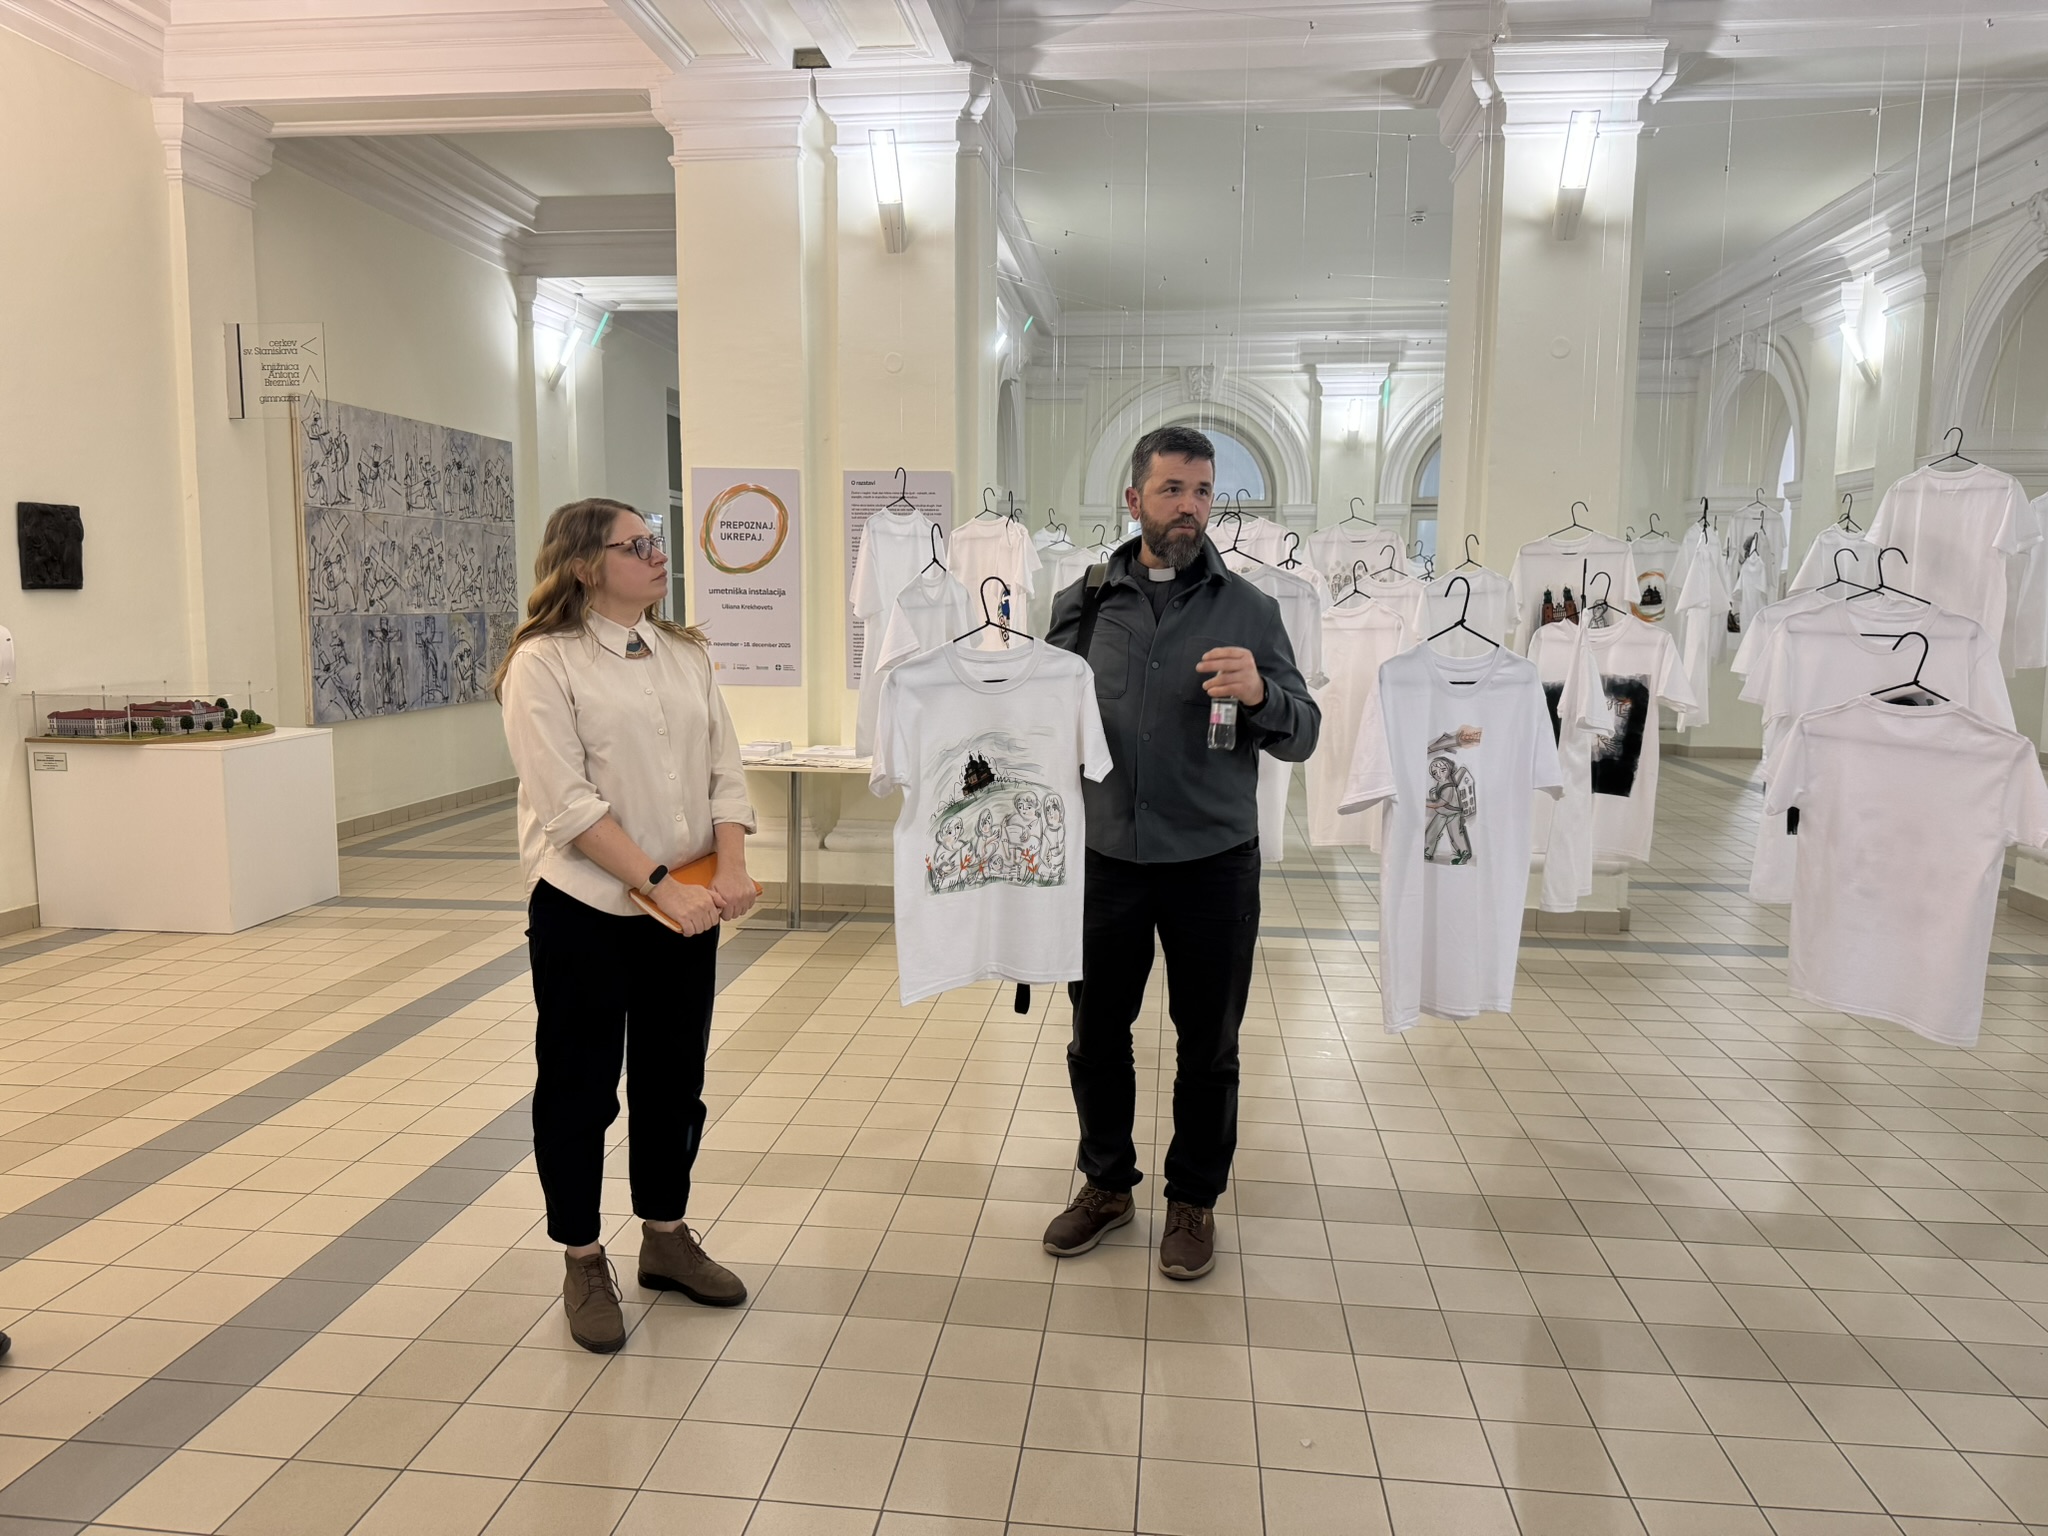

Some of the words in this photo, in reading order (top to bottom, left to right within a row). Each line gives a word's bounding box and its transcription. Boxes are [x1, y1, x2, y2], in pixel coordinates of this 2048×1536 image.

[269, 339, 297, 347] cerkev
[254, 347, 298, 355] Stanislava
[268, 371, 300, 379] Antona
[264, 378, 300, 387] Breznika
[720, 521, 776, 530] PREPOZNAJ.
[720, 532, 764, 541] UKREPAJ.
[708, 587, 747, 595] umetniška
[748, 588, 786, 597] instalacija
